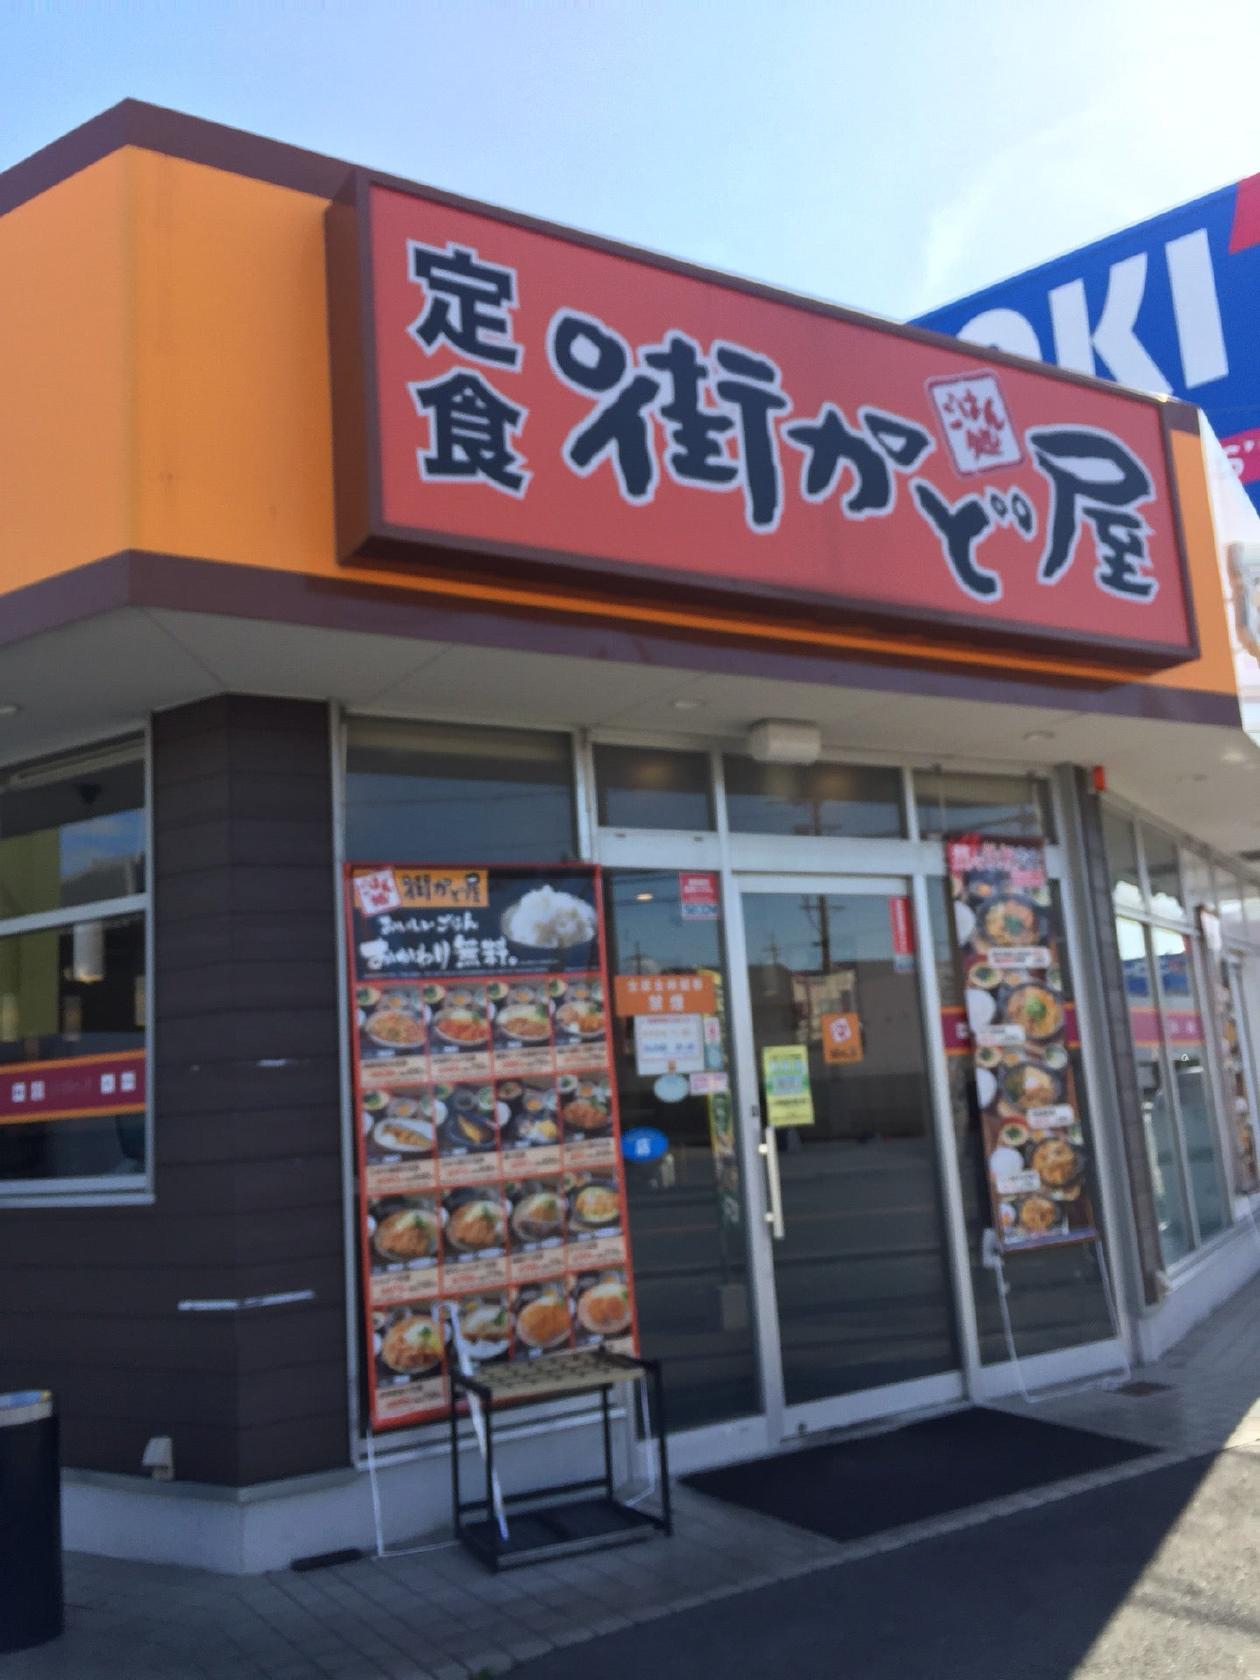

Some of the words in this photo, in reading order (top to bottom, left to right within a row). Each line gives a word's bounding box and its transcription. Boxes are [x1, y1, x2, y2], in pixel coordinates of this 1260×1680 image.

[407, 238, 533, 500] 定食
[546, 306, 1160, 605] 街かど屋
